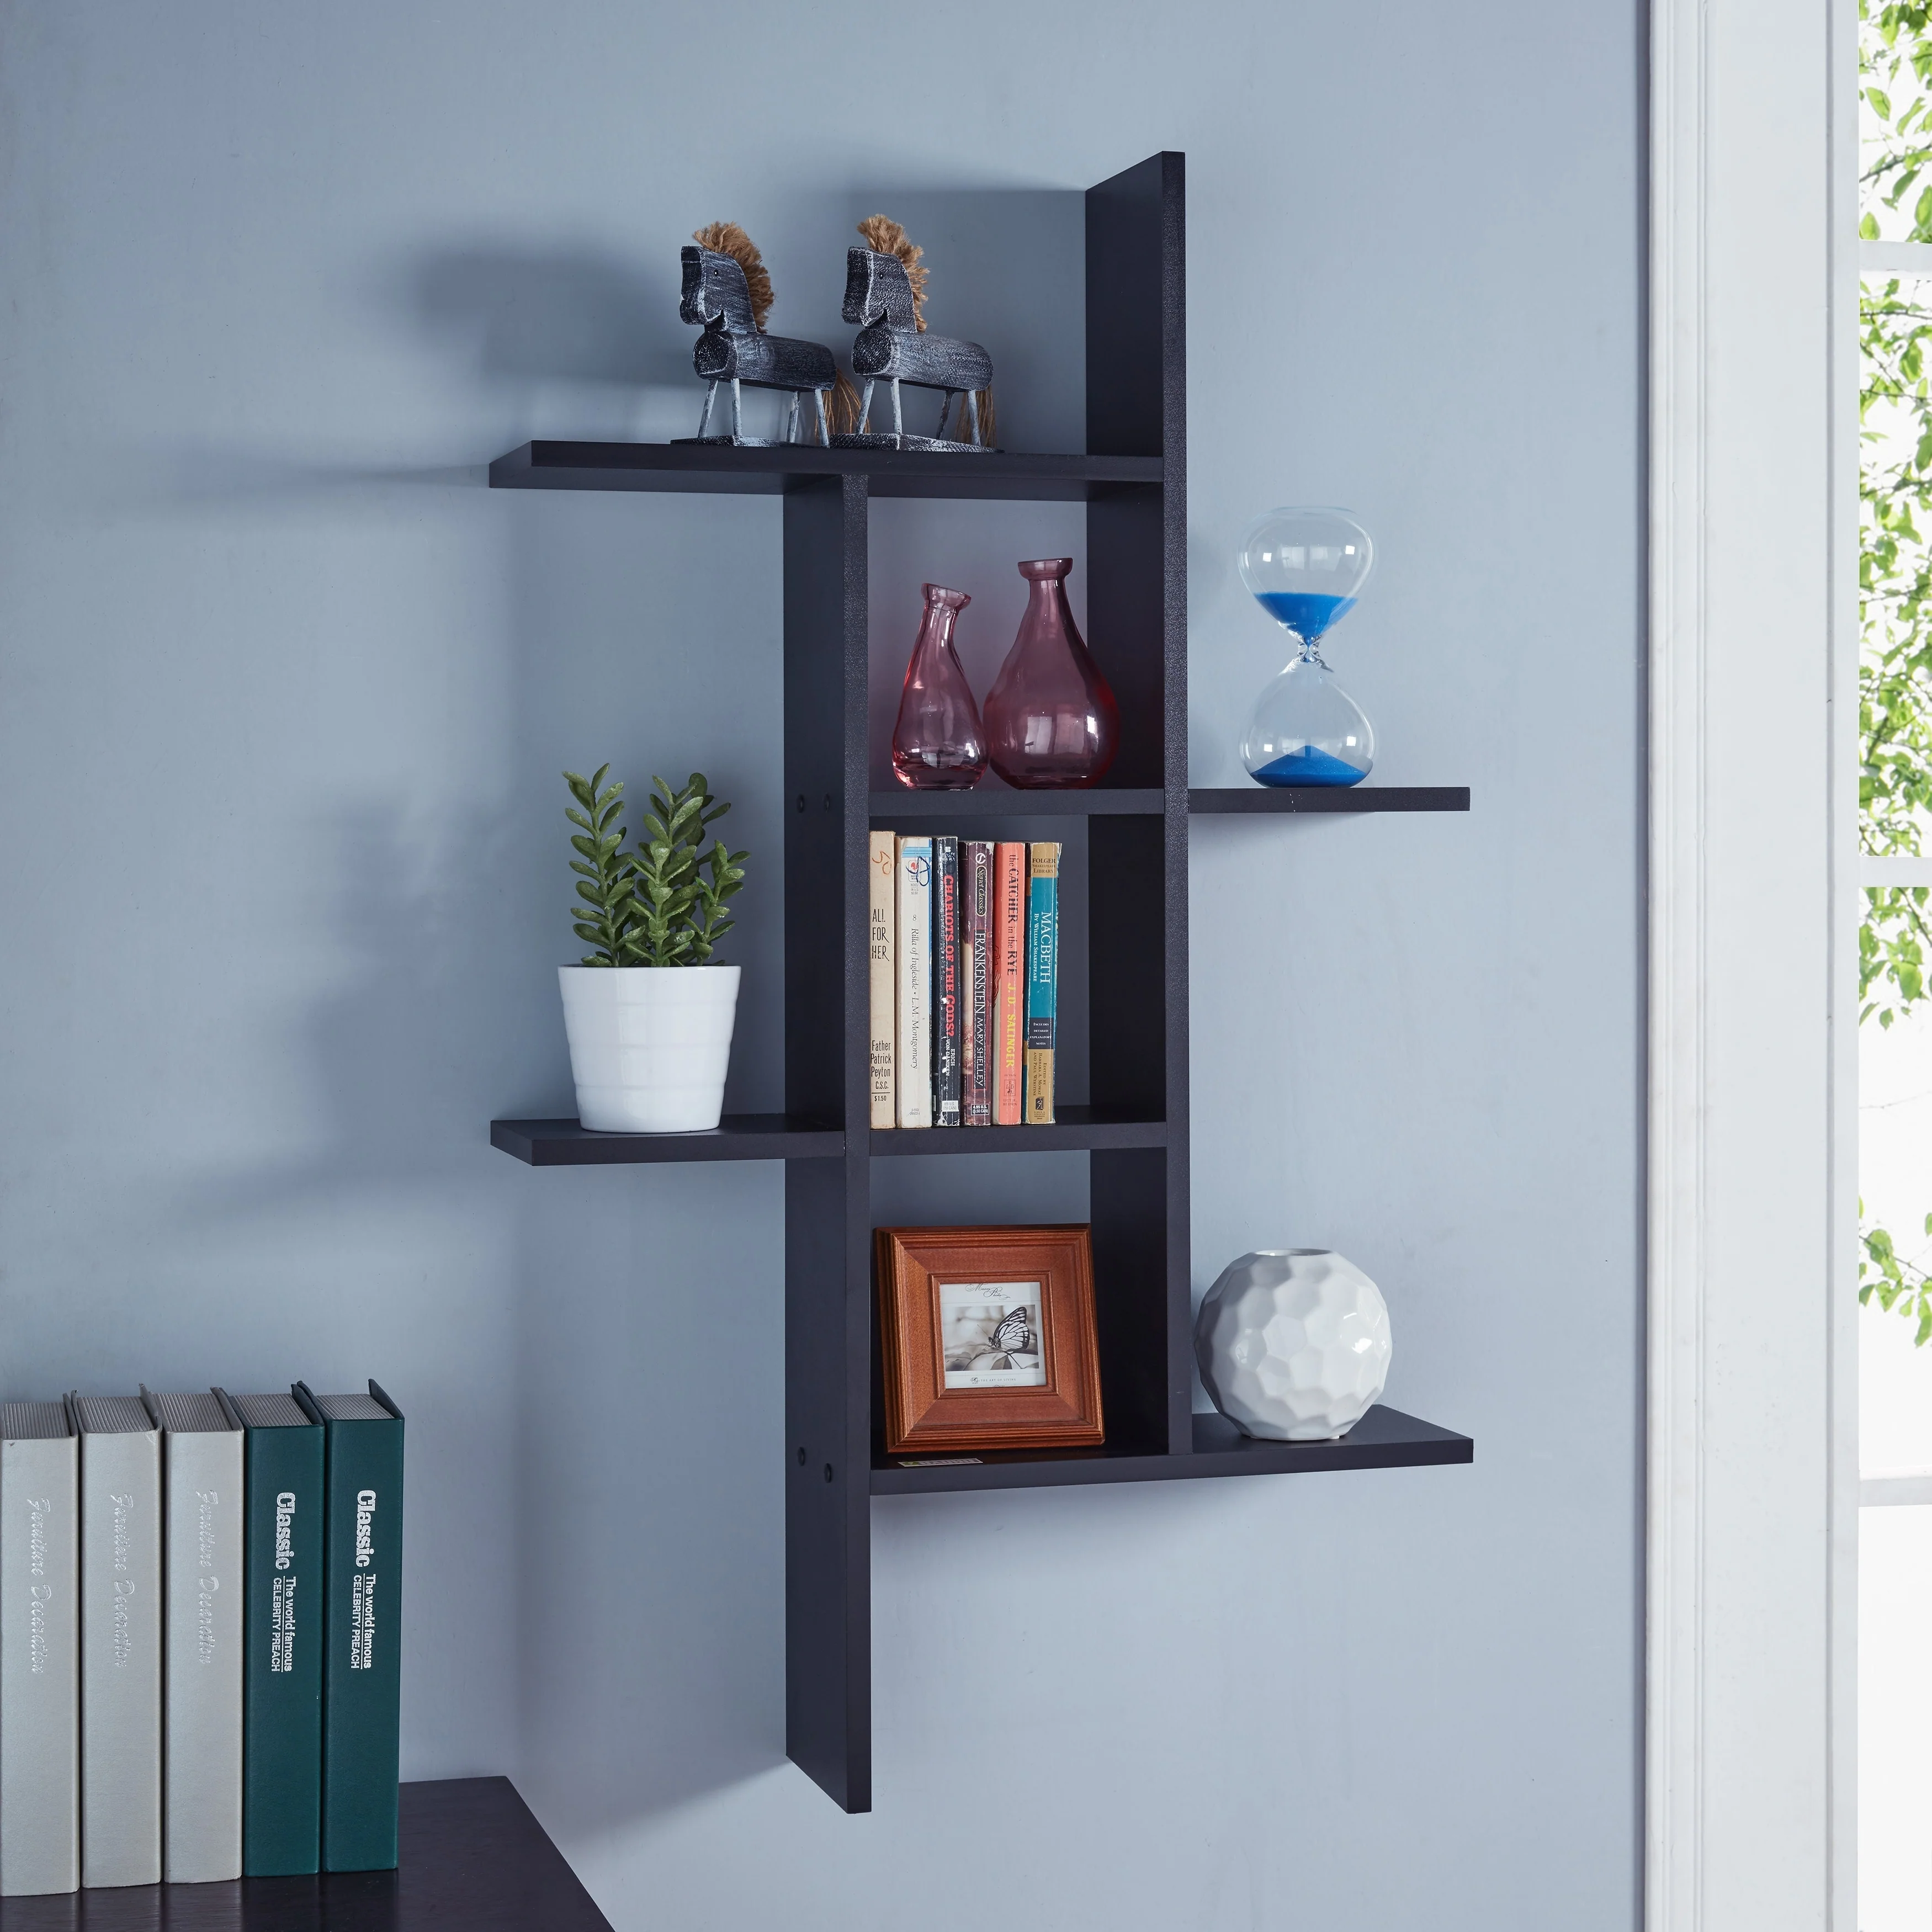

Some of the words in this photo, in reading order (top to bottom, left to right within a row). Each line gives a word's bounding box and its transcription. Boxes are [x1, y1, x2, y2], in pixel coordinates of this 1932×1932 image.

[1009, 854, 1019, 867] the
[943, 875, 954, 942] CHARIOTS
[1008, 868, 1019, 923] CATCHER
[1034, 913, 1039, 921] BY
[872, 927, 890, 943] FOR
[1007, 936, 1017, 948] the
[1040, 911, 1052, 983] MACBETH
[872, 945, 890, 962] HER
[945, 945, 954, 962] OF
[1007, 951, 1017, 975] RYE
[910, 957, 919, 990] Ingleside
[946, 965, 954, 991] THE
[975, 933, 985, 1013] FRANKENSTEIN
[1008, 983, 1016, 992] J.
[946, 995, 956, 1036] GODS?
[1007, 996, 1016, 1007] D.
[872, 1040, 891, 1051] Father
[910, 1020, 919, 1069] Montgomery
[1006, 1014, 1016, 1068] SALINGER
[871, 1053, 891, 1064] Patrick
[871, 1066, 890, 1079] Peyton
[875, 1081, 889, 1089] C.S.C.
[275, 1492, 296, 1570] Classic
[355, 1490, 376, 1567] Classic
[285, 1576, 296, 1597] The
[365, 1574, 376, 1594] The
[272, 1578, 282, 1631] CELEBRITY
[285, 1599, 295, 1630] world
[352, 1574, 362, 1627] CELEBRITY
[364, 1596, 375, 1627] world
[271, 1632, 281, 1671] PREACH
[284, 1632, 295, 1672] famous
[351, 1629, 360, 1669] PREACH
[363, 1629, 375, 1669] famous
